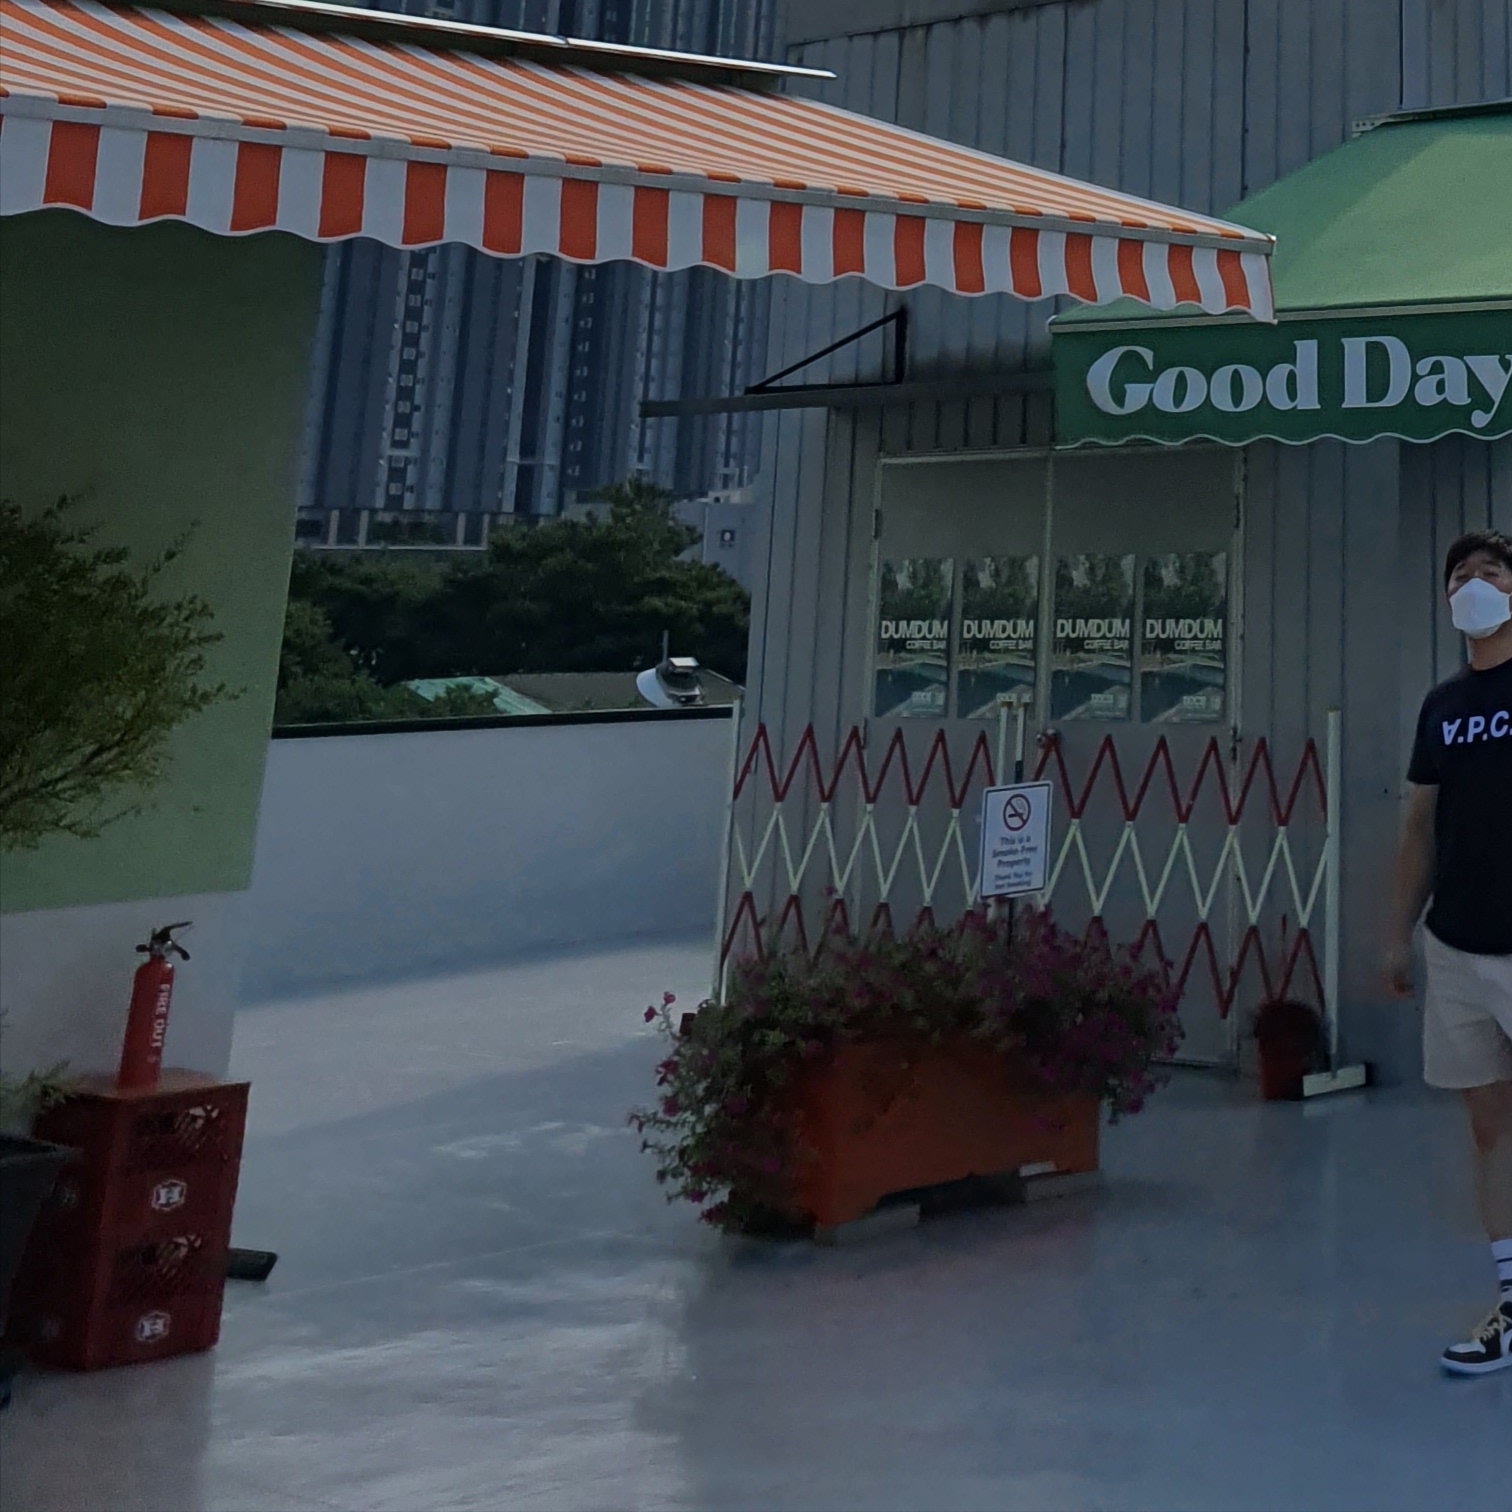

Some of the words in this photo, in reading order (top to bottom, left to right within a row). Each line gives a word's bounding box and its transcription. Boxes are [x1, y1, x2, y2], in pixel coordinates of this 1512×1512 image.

[1085, 340, 1322, 416] Good
[881, 619, 949, 639] DUMDUM
[962, 619, 1035, 639] DUMDUM
[1056, 618, 1130, 638] DUMDUM
[1145, 618, 1224, 639] DUMDUM
